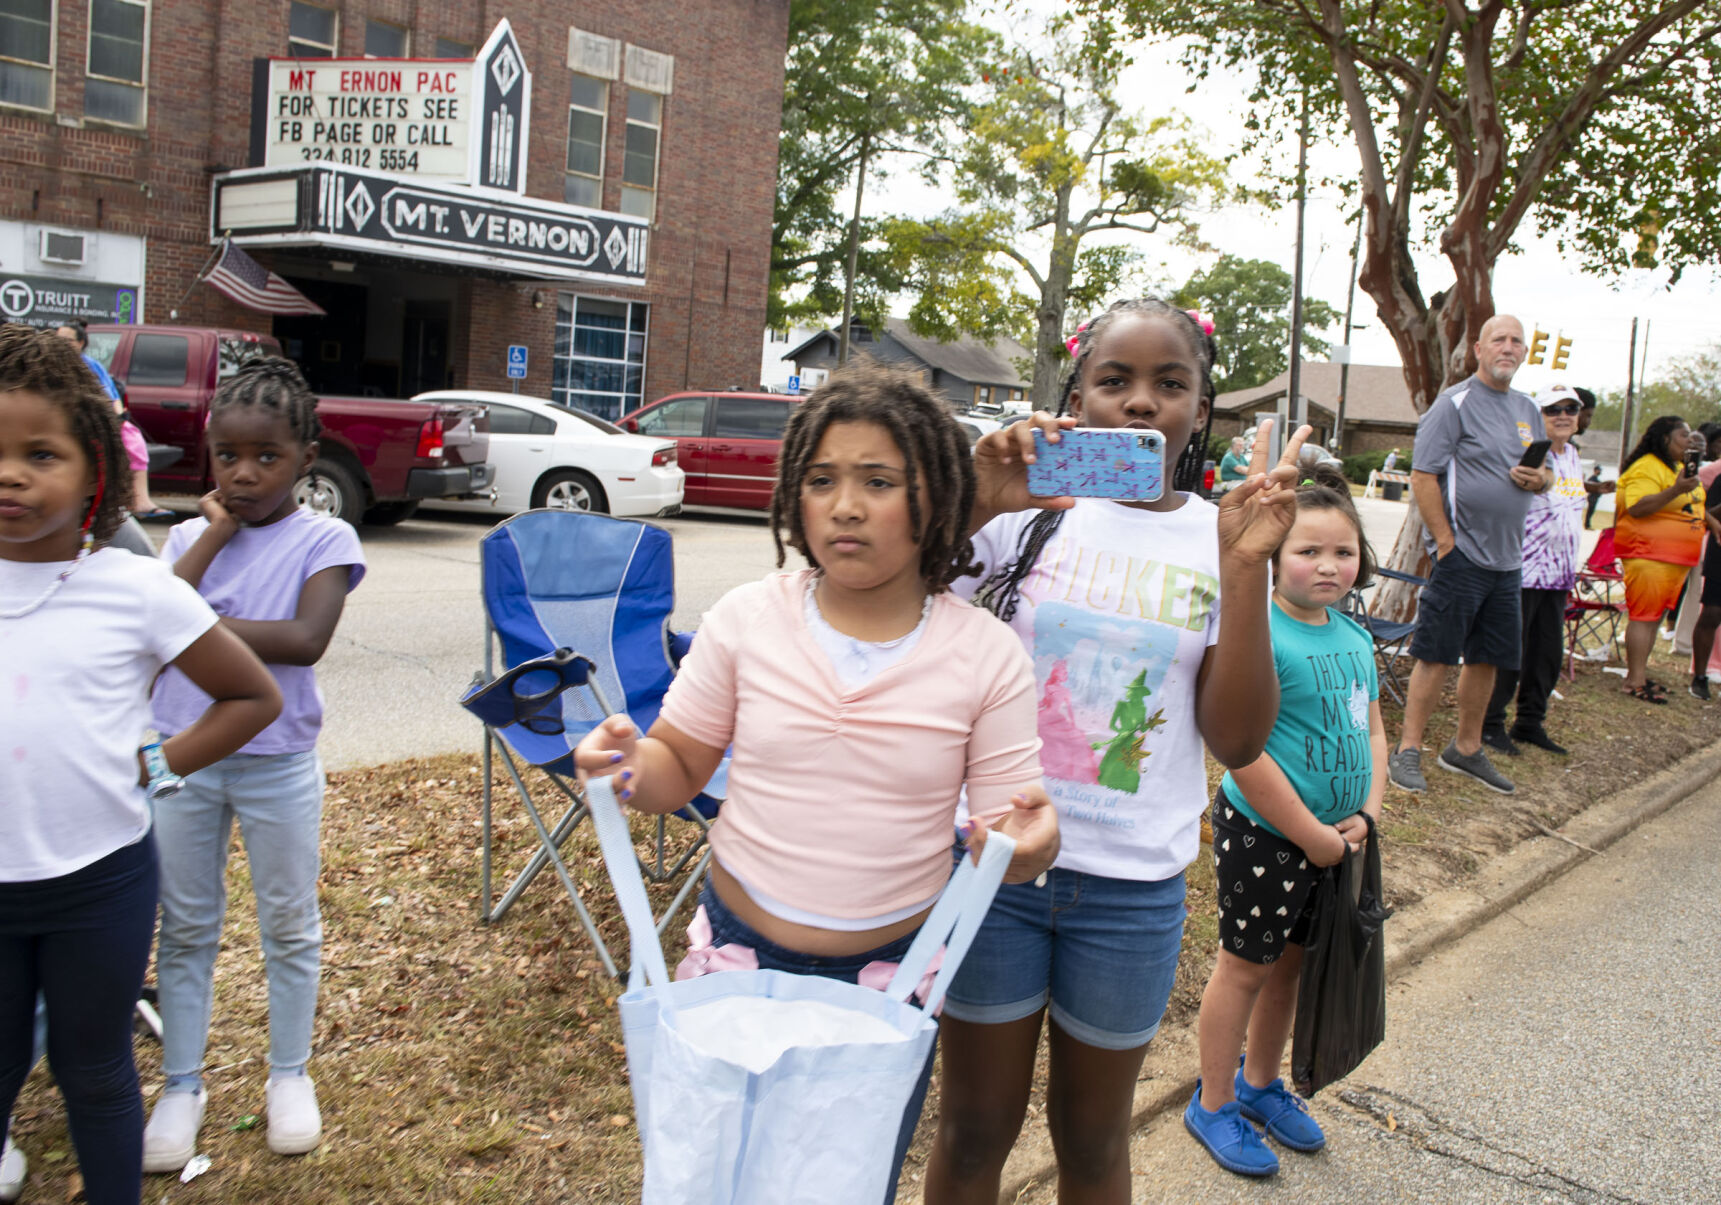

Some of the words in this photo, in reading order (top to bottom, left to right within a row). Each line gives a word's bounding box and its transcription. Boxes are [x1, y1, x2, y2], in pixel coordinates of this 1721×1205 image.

[289, 70, 316, 91] MT
[340, 70, 402, 93] ERNON
[417, 71, 457, 93] PAC
[278, 96, 313, 116] FOR
[328, 96, 408, 119] TICKETS
[423, 98, 458, 119] SEE
[279, 121, 302, 142] FB
[314, 122, 362, 143] PAGE
[372, 123, 396, 144] OR
[407, 124, 453, 145] CALL
[342, 148, 371, 169] 812
[380, 149, 419, 171] 5554
[394, 199, 449, 234] MT.
[460, 209, 589, 256] VERNON
[35, 289, 91, 308] TRUITT
[1305, 653, 1347, 692] THIS
[1347, 651, 1368, 687] IS
[1321, 693, 1354, 732] MY
[1305, 732, 1372, 773] READI
[1065, 784, 1102, 808] Story
[1325, 772, 1372, 813] SHIR
